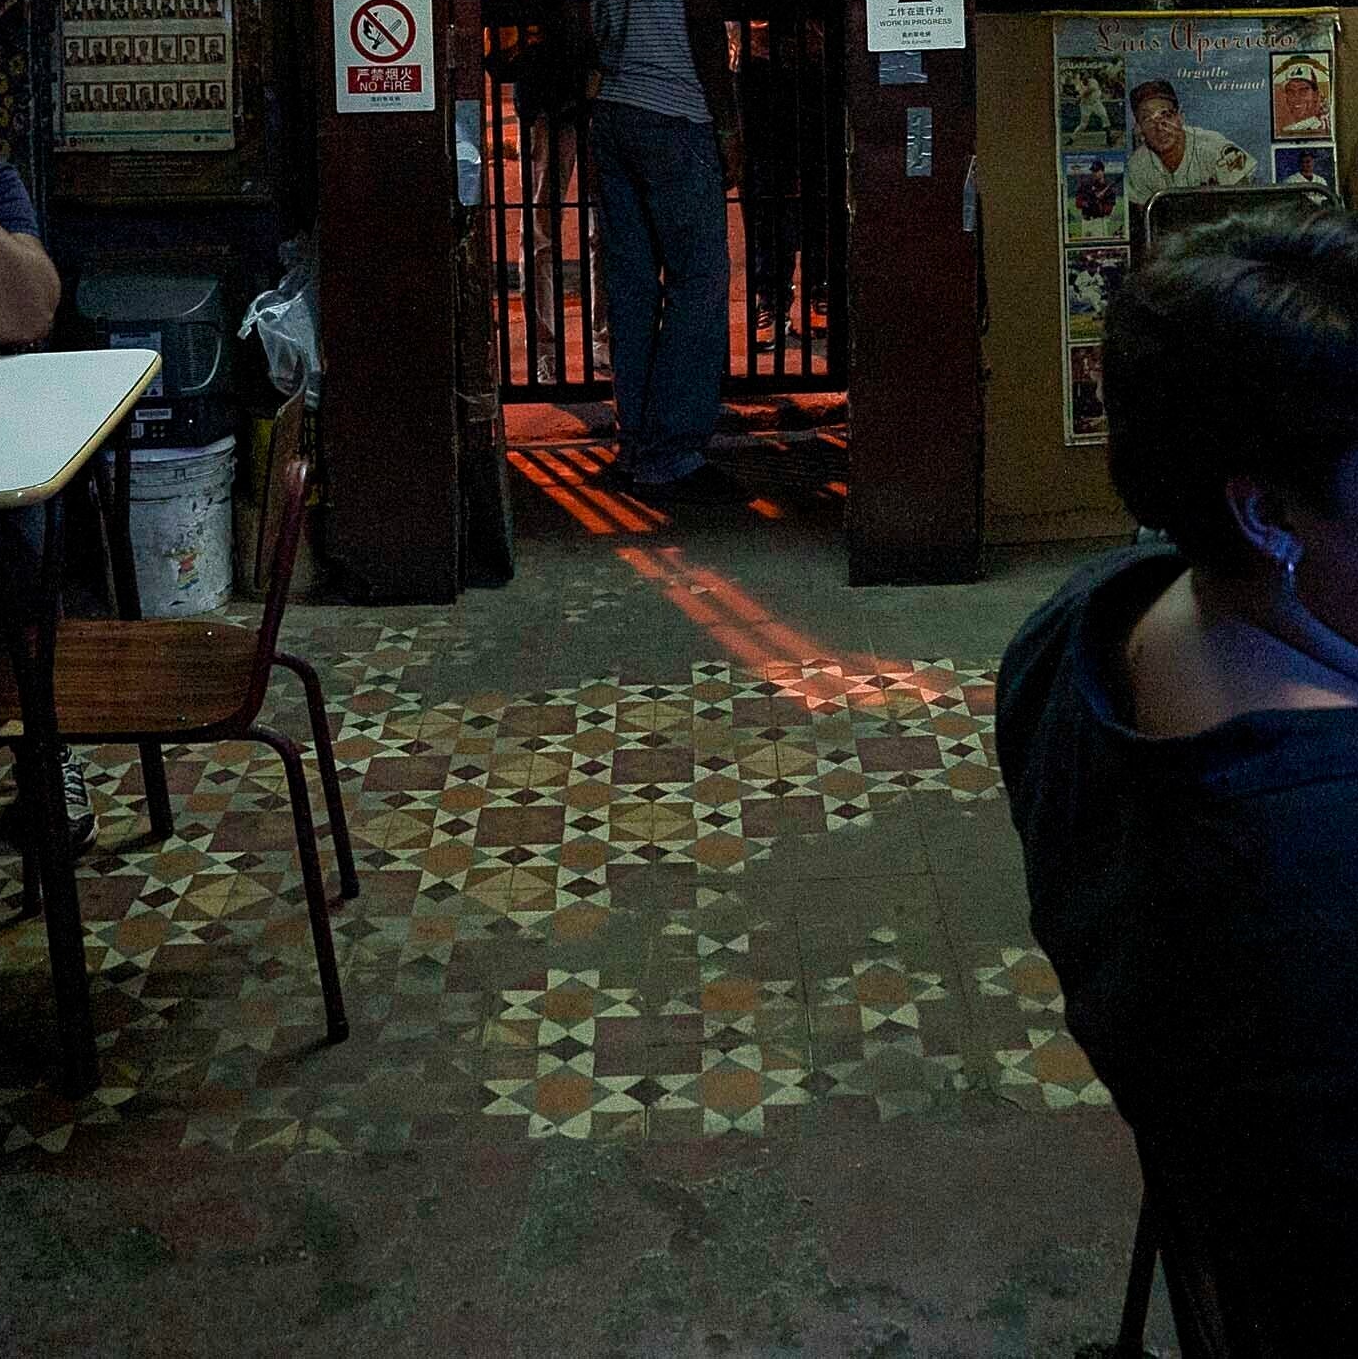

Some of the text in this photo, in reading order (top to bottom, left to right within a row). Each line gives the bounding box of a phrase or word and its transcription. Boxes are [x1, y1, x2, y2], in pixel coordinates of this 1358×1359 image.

[888, 6, 944, 17] 工作在进行中
[912, 17, 953, 26] PROGRESS
[1095, 17, 1298, 64] Luis Aparicio
[356, 66, 414, 82] 严禁烟火
[359, 80, 412, 92] NO FIRE
